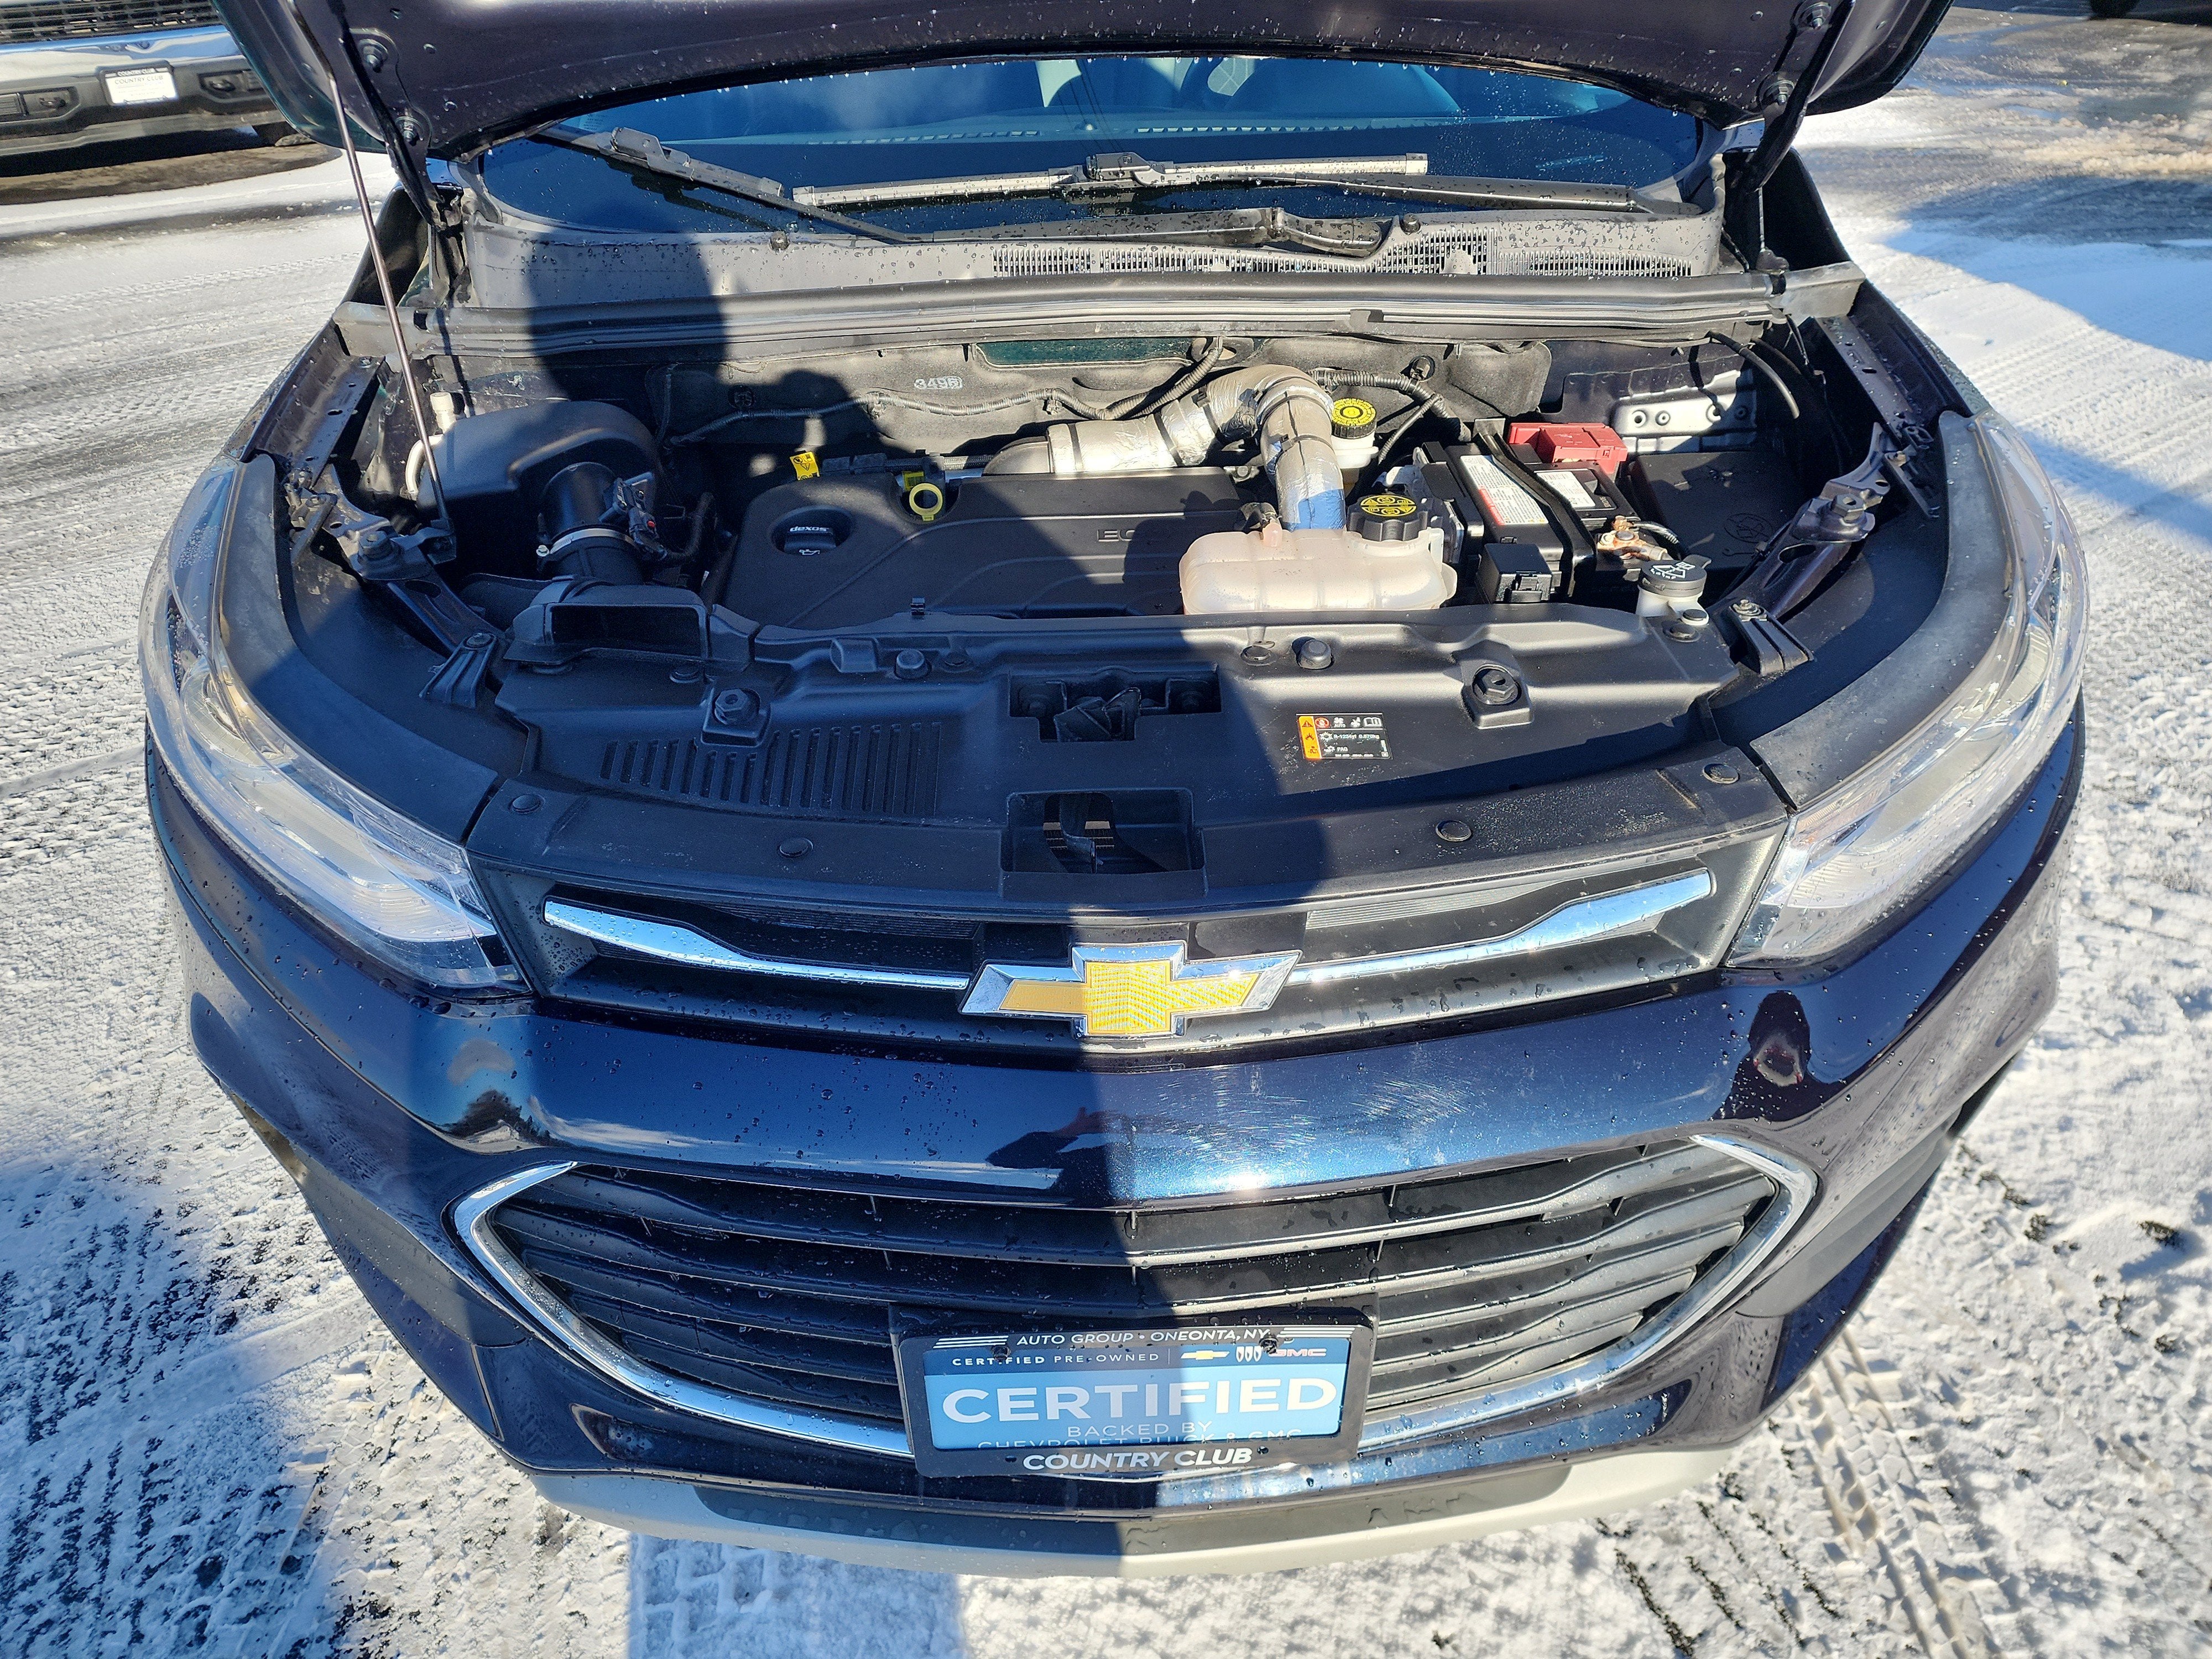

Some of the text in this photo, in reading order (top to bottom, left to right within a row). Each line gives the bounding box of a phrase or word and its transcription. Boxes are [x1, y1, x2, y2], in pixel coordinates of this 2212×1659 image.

[1016, 1334, 1065, 1346] AUTO
[1071, 1332, 1134, 1344] GROUP
[1150, 1329, 1241, 1342] ONEONTA,
[952, 1353, 1159, 1366] CERTFIED PRE-OWNED
[1268, 1348, 1327, 1357] GMC
[942, 1378, 1337, 1424] CERTIFIED
[1067, 1421, 1213, 1438] BACKED BY
[1022, 1447, 1254, 1471] COUNTRY CLUB
